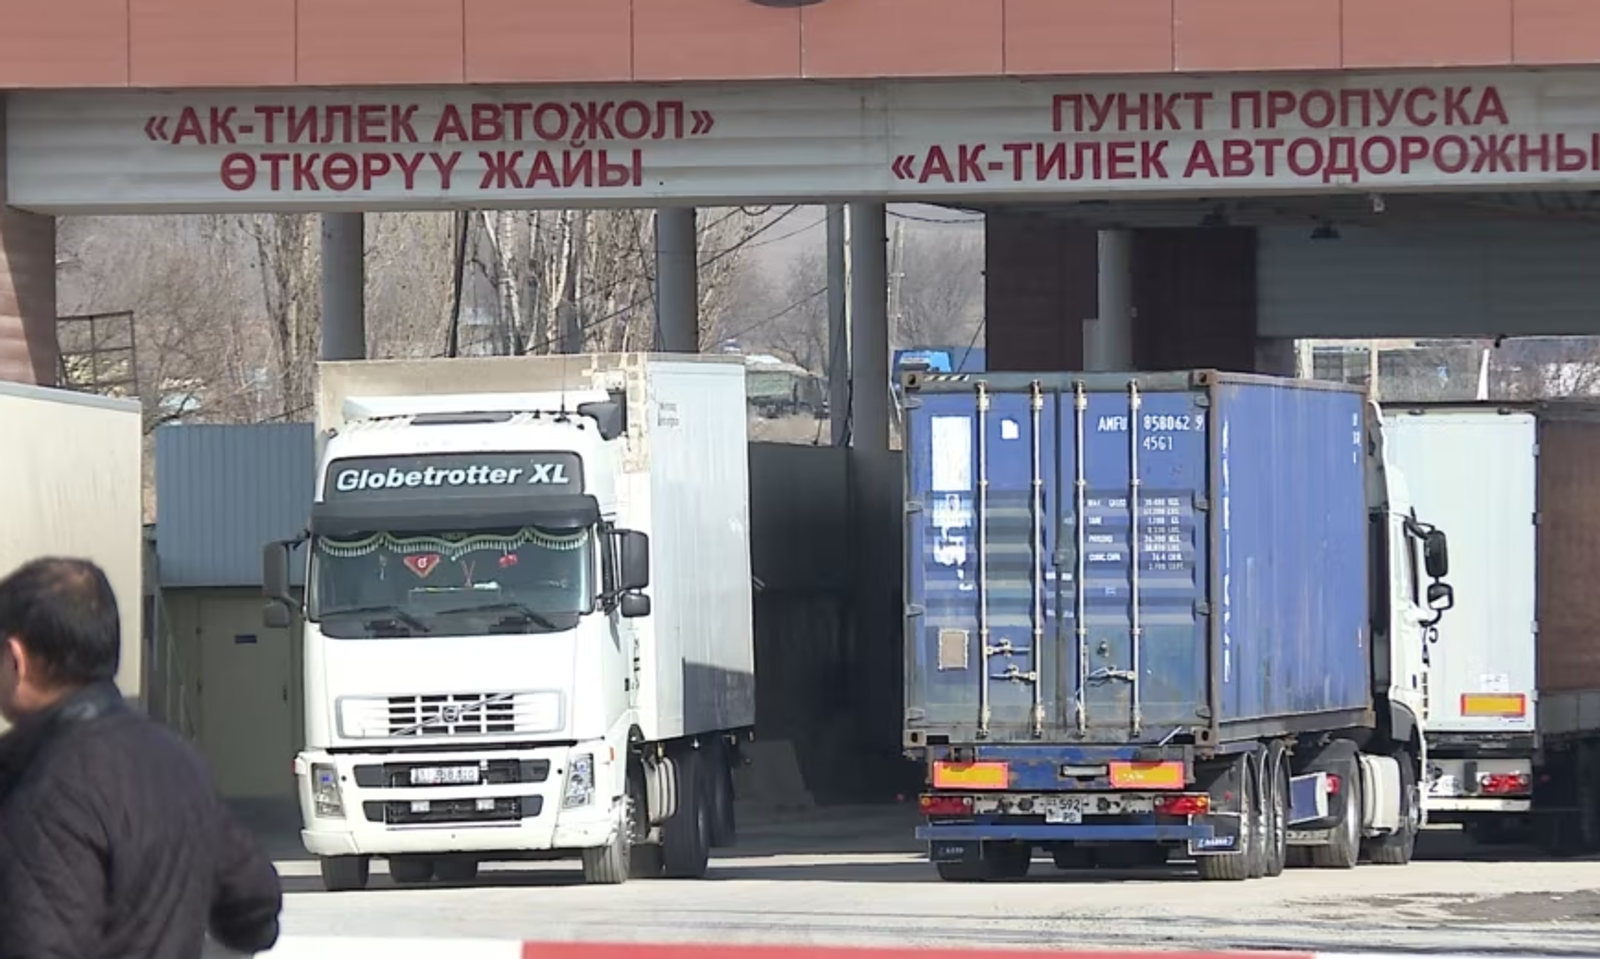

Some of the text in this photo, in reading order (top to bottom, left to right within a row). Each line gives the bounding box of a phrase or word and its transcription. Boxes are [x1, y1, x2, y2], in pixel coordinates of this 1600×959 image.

[144, 101, 714, 144] «АК-ТИЛЕК АВТОЖОЛ»
[1051, 86, 1509, 132] ПУНКТ ПРОПУСКА
[220, 140, 643, 191] ӨТКӨРҮҮ ЖАЙЫ
[891, 132, 1600, 182] «АК-ТИЛЕК АВТОДОРОЖНЫ
[1143, 415, 1191, 432] 858062
[337, 464, 569, 490] Globetrotter XL
